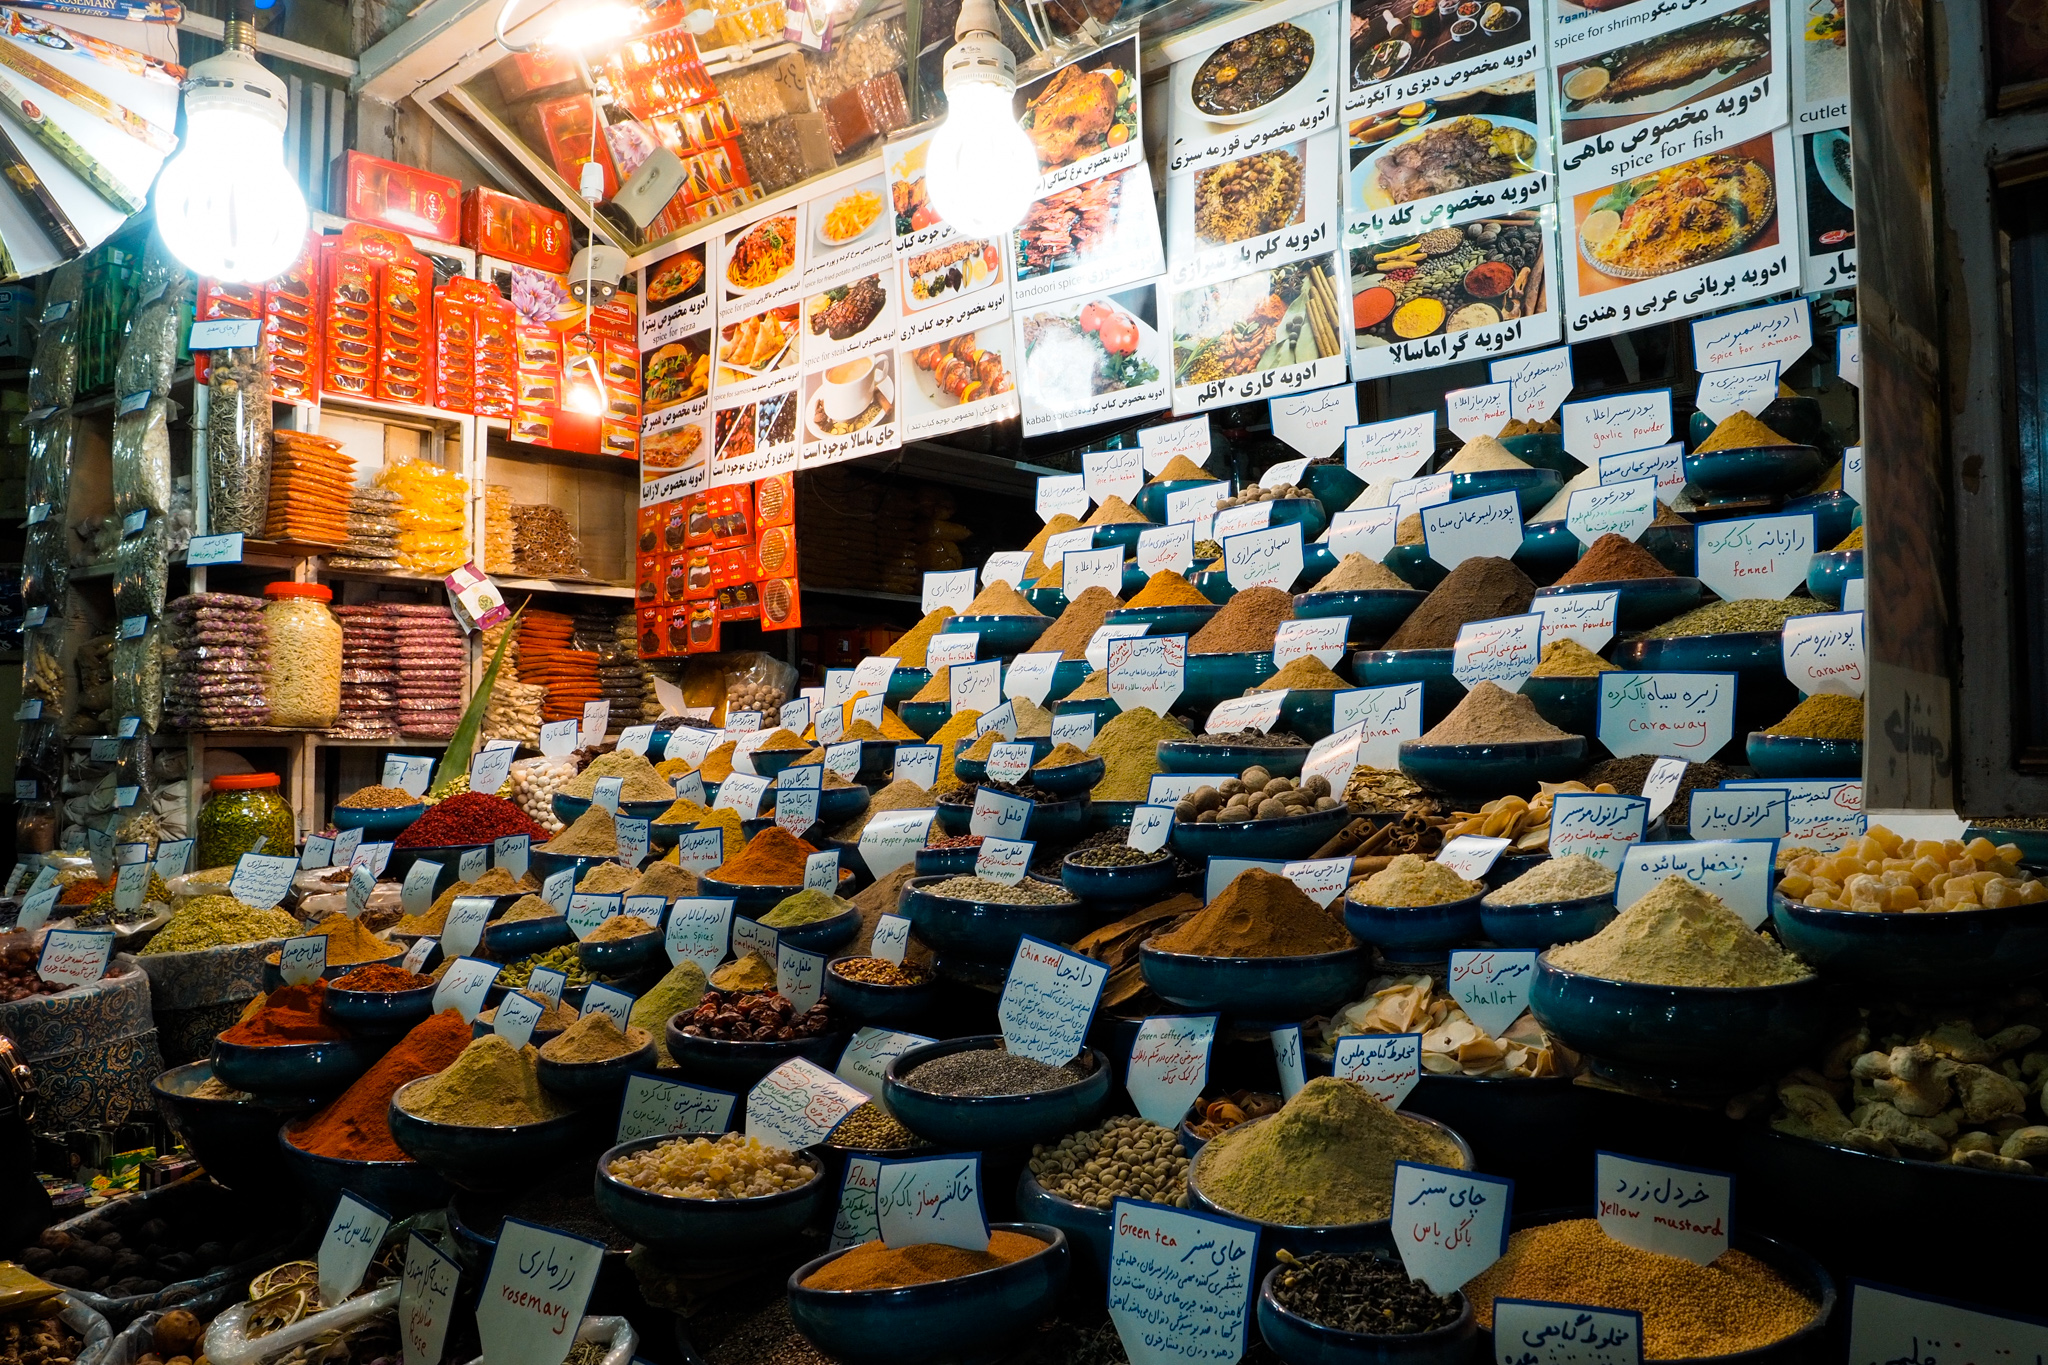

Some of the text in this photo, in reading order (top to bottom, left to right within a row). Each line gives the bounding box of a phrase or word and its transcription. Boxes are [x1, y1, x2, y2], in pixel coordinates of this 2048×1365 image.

[59, 5, 110, 17] ROMERO
[1650, 1, 1678, 22] میگو
[1554, 11, 1650, 49] spice for shrimp
[1503, 44, 1537, 68] ادویه
[1407, 75, 1440, 96] دیزی
[1443, 59, 1499, 87] مخصوص
[1344, 83, 1392, 111] آبگوشت
[1397, 89, 1403, 100] و
[1714, 77, 1771, 118] ادویه
[1800, 103, 1847, 123] cutlet
[1171, 105, 1329, 171] ادویه مخصوص قورمه سبزی
[1620, 104, 1709, 152] مخصوص
[1113, 146, 1130, 162] ادویه
[1563, 135, 1615, 171] ماهی
[1611, 125, 1724, 177] spice for fish
[1069, 166, 1082, 180] مرغ
[1084, 156, 1111, 175] مخصوص
[1348, 175, 1547, 239] ادویه مخصوص کله پاچه
[896, 235, 916, 255] کباب
[917, 229, 939, 246] جوجه
[1285, 222, 1326, 251] ادویه
[1232, 245, 1250, 265] پلو
[1255, 236, 1281, 264] کلم
[1572, 255, 1787, 333] ادویه بریانی عربی و هندی
[642, 295, 708, 335] ادویه مخصوص پیتزا
[719, 306, 734, 318] spice
[734, 304, 742, 312] for
[900, 293, 1005, 341] ادویه مخصوص جوجه کباب لاری
[652, 322, 696, 344] spice for pizza
[862, 335, 882, 348] مخصوص
[883, 329, 895, 340] ادویه
[1706, 308, 1799, 350] ادویه سمبوسه
[1389, 321, 1522, 365] ادویه گراماسالا
[1739, 343, 1755, 356] for
[1761, 334, 1801, 349] samosa
[804, 345, 846, 368] spice for steak
[1240, 371, 1276, 397] کاری
[1280, 362, 1316, 388] ادویه
[1078, 388, 1165, 415] ادویه مخصوص کباب کوبیده
[1026, 411, 1051, 426] kabab
[1306, 419, 1328, 429] clove
[1459, 409, 1507, 424] onion powder
[803, 425, 894, 460] چای ماسالا موجود است
[1593, 422, 1665, 449] garlic powder
[713, 467, 726, 477] است
[727, 464, 746, 476] موجود
[642, 470, 706, 501] ادویه مخصوص لازانیا
[1232, 537, 1291, 565] سماق شیرازی
[1758, 528, 1805, 556] رازیانه
[1733, 559, 1775, 577] fennel
[1251, 576, 1279, 587] sumac
[1541, 618, 1614, 636] arjoram powder
[1306, 641, 1345, 652] for shrimp
[1381, 687, 1419, 725] گلپر
[1647, 680, 1677, 710] سیاه
[1683, 683, 1719, 714] زیره
[1560, 803, 1645, 827] گرانول موسیر
[1701, 799, 1786, 830] گرانول پیاز
[880, 837, 902, 847] pepper
[903, 834, 926, 847] powder
[1042, 953, 1059, 968] seed
[1453, 953, 1530, 987] موسیر پاک کرده
[1068, 964, 1093, 987] دانه
[1465, 985, 1517, 1006] shallot
[1138, 1027, 1181, 1042] Green coffee
[848, 1165, 877, 1188] Flax
[880, 1172, 906, 1217] کرده
[897, 1174, 916, 1219] پاک
[916, 1182, 940, 1216] ممتاز
[1408, 1178, 1486, 1218] چای سبز
[1616, 1178, 1709, 1208] خردل زرد
[1119, 1213, 1177, 1247] Green tea
[1413, 1222, 1440, 1245] یاس
[1654, 1216, 1724, 1236] mustard
[1180, 1229, 1246, 1271] چای سبز
[518, 1246, 576, 1291] رزماری
[502, 1284, 569, 1335] rosemary
